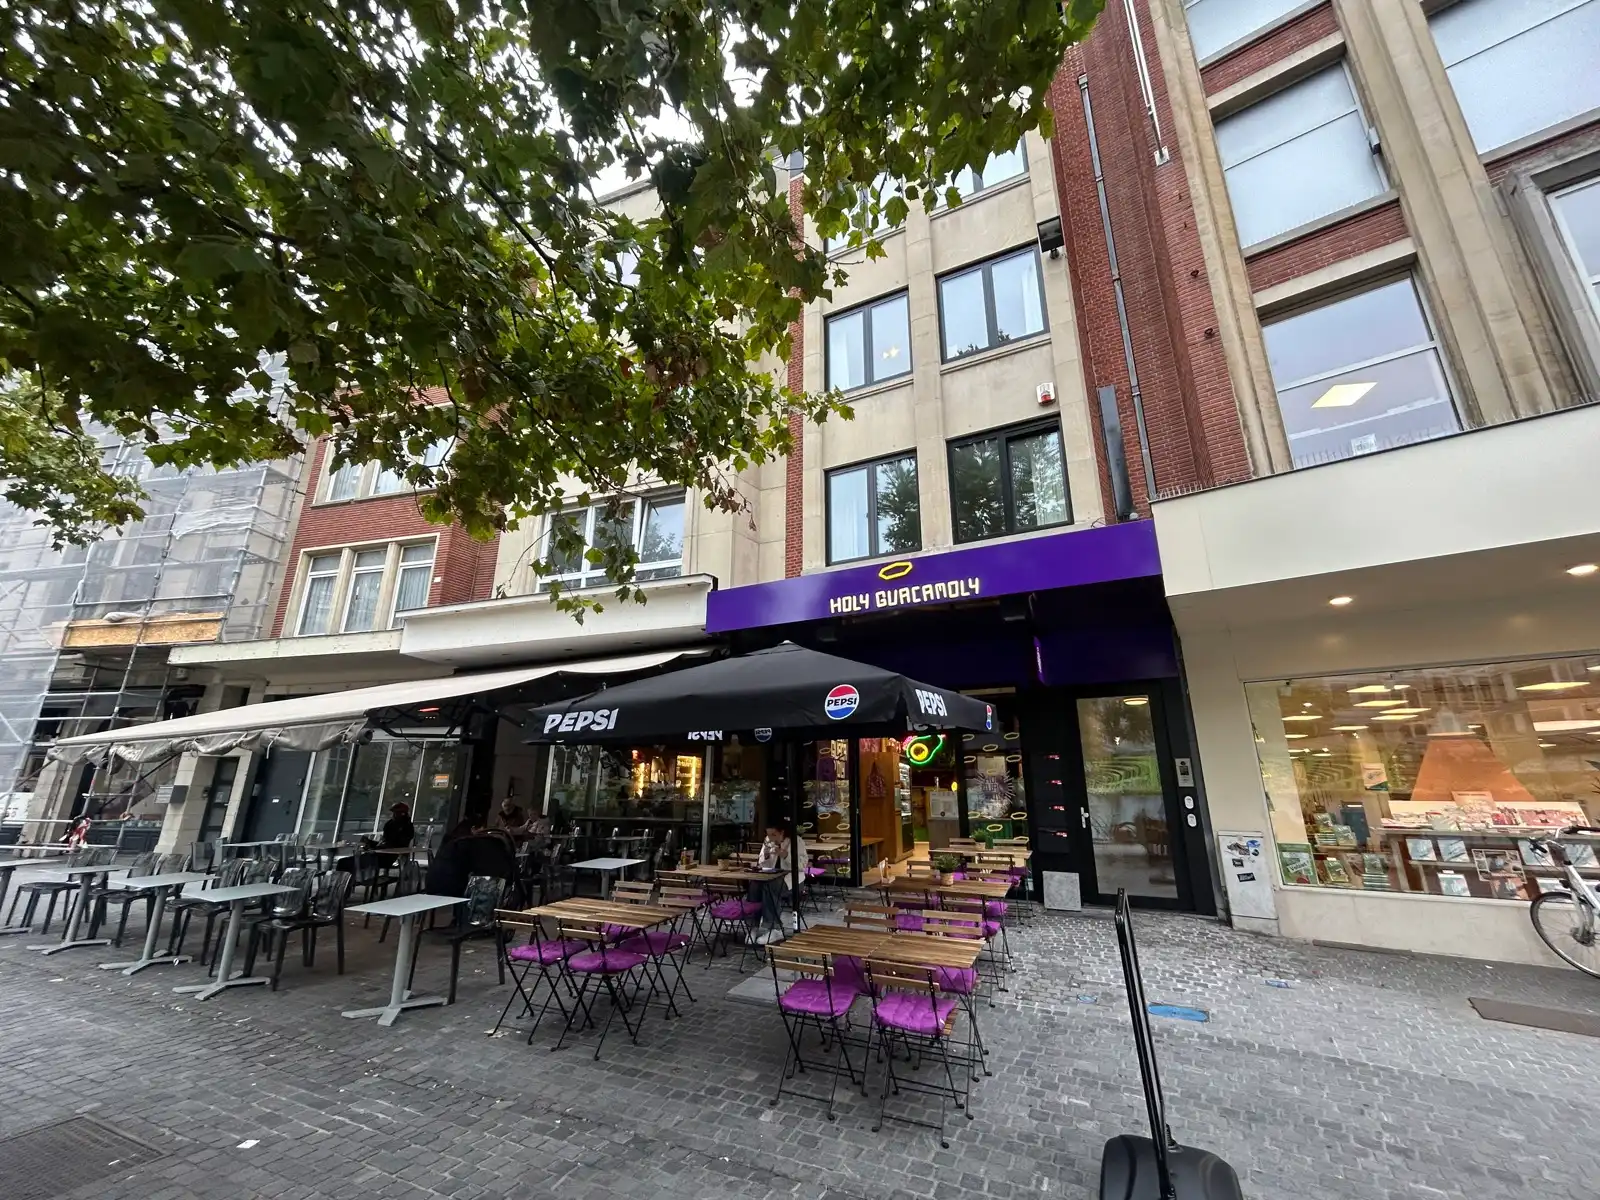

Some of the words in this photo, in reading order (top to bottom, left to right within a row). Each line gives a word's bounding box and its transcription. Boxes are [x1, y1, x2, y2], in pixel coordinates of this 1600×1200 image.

[829, 593, 870, 614] HOLY
[875, 577, 980, 608] GUACAMOLY
[826, 697, 858, 708] PEPSI
[915, 688, 948, 717] PEPSI
[543, 708, 620, 734] PEPSI
